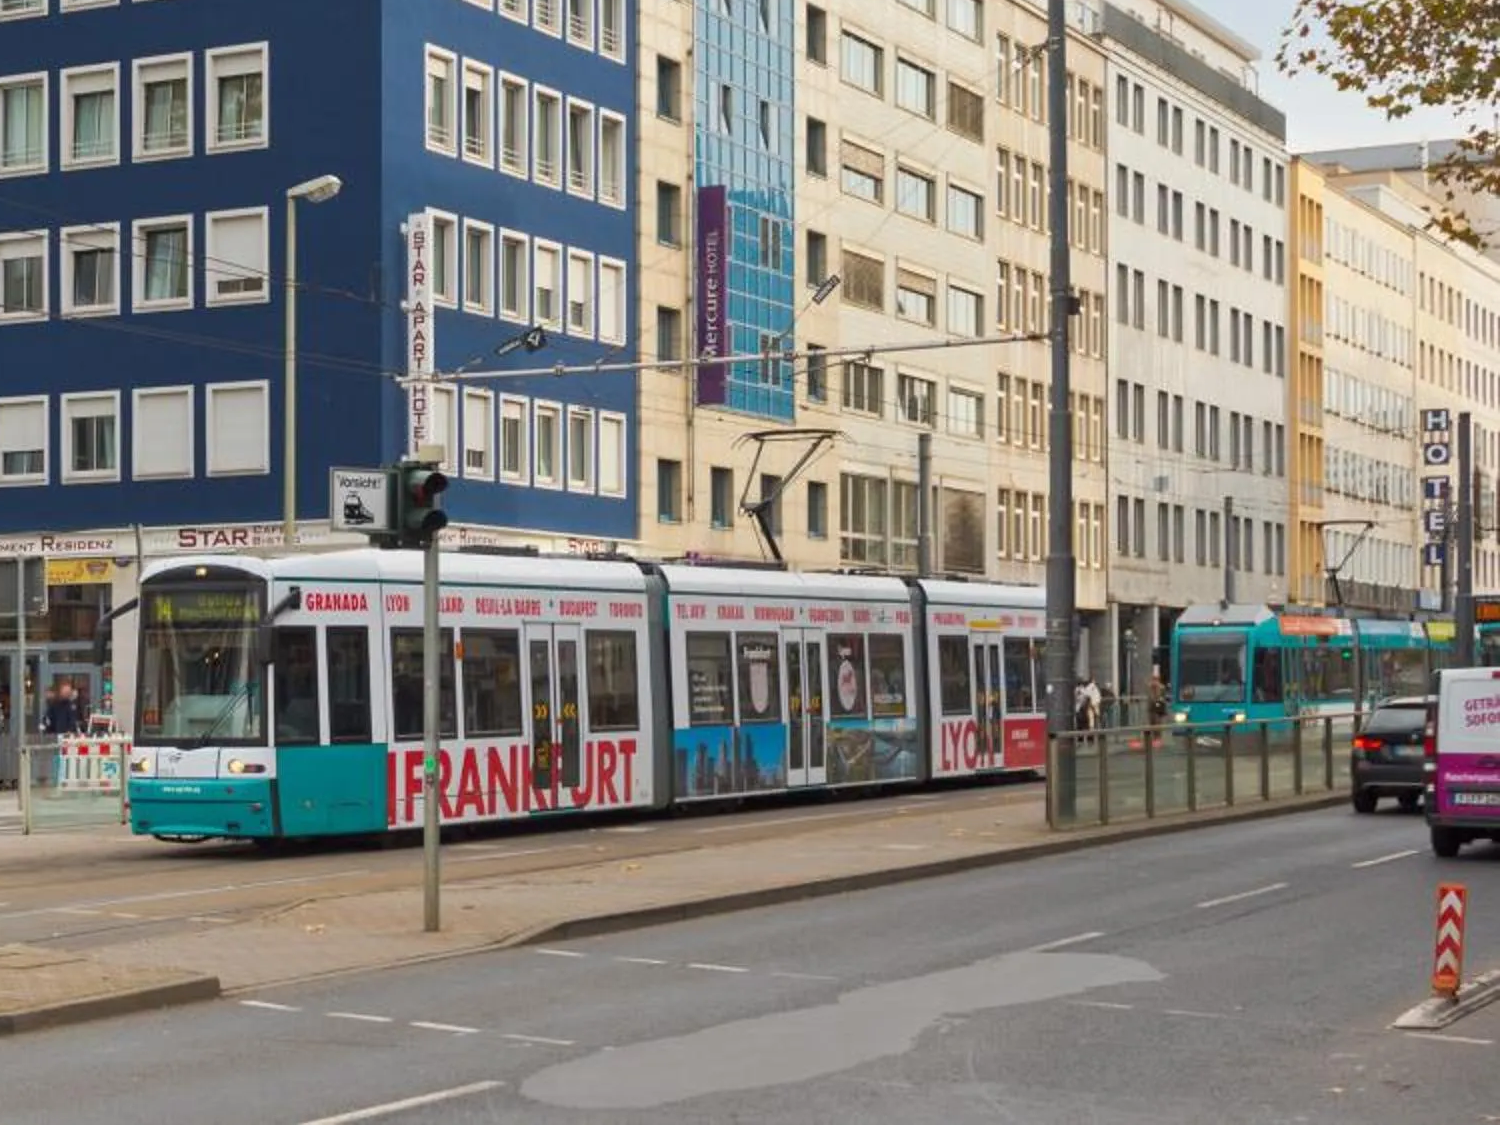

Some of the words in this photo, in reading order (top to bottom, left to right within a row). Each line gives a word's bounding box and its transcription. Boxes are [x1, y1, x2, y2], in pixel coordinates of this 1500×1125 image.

[412, 231, 425, 286] STAR
[412, 301, 426, 369] APART
[1426, 410, 1448, 564] HOTEL
[41, 536, 113, 551] RESIDENZ
[179, 529, 249, 547] STAR
[306, 593, 368, 612] GRANADA
